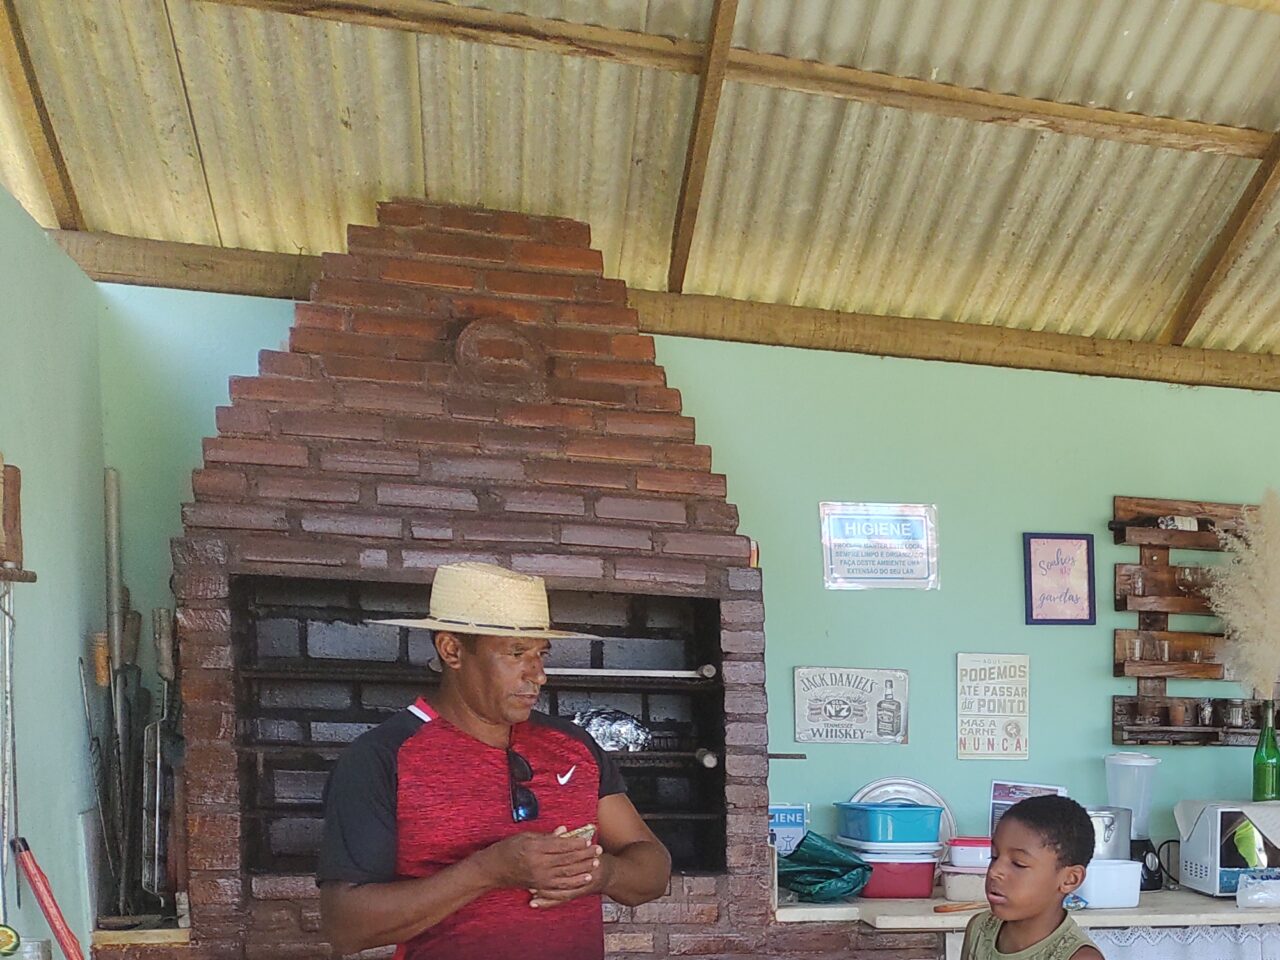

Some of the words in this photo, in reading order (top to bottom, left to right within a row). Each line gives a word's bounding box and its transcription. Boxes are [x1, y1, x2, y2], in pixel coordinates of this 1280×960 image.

[845, 521, 912, 536] HIGIENE
[847, 567, 879, 575] EXTENSÃO
[1035, 587, 1081, 609] gavetas
[960, 664, 1027, 682] PODEMOS
[800, 672, 829, 692] JACK
[960, 683, 979, 696] ATÉ
[983, 686, 1027, 698] PASSAR
[977, 699, 1026, 714] PONTO
[960, 719, 985, 727] MAS
[989, 719, 996, 727] A
[810, 728, 866, 739] WHISKEY
[960, 727, 997, 736] CARNE
